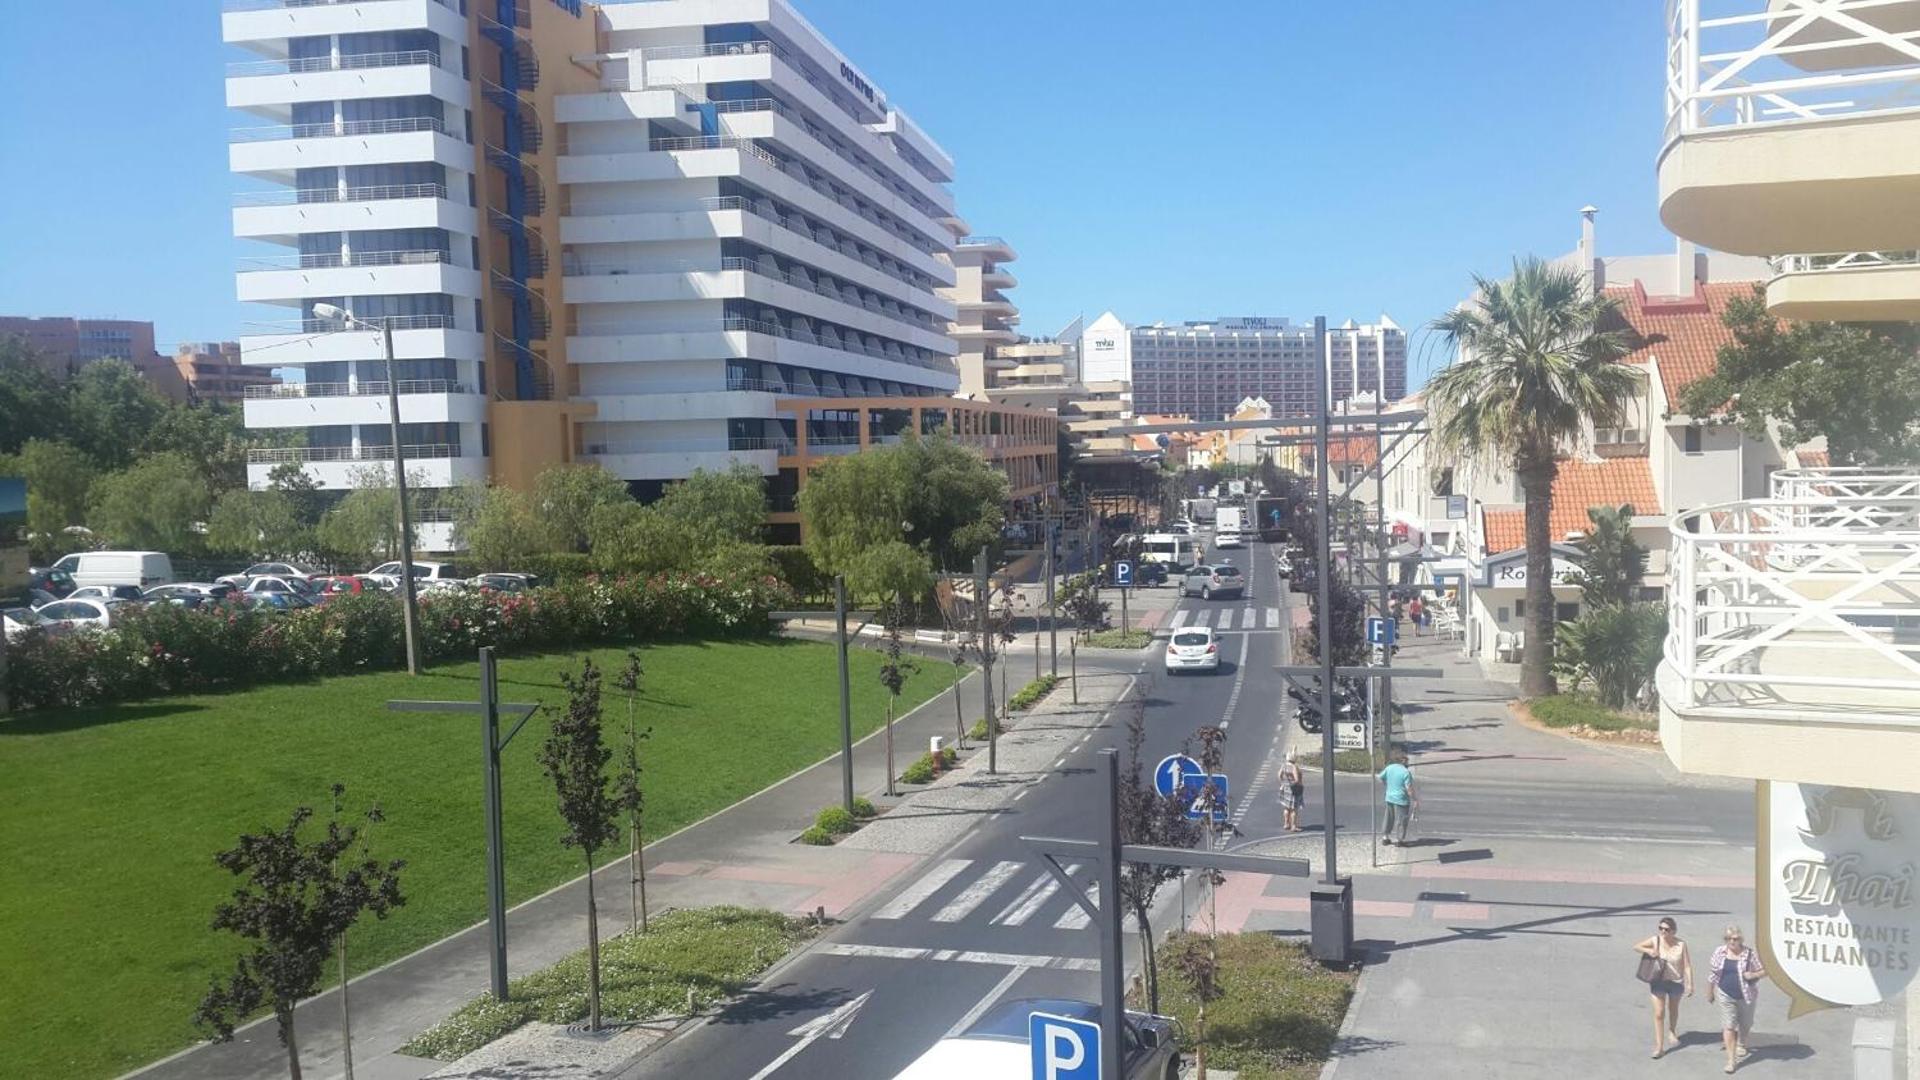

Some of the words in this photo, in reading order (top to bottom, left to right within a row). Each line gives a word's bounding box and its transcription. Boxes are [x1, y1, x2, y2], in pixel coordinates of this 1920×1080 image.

[1118, 563, 1130, 579] P
[1782, 852, 1914, 909] Thai
[1783, 917, 1911, 945] RESTAURANTE
[1783, 940, 1910, 971] TAILANDÊS
[1045, 1023, 1085, 1080] P
